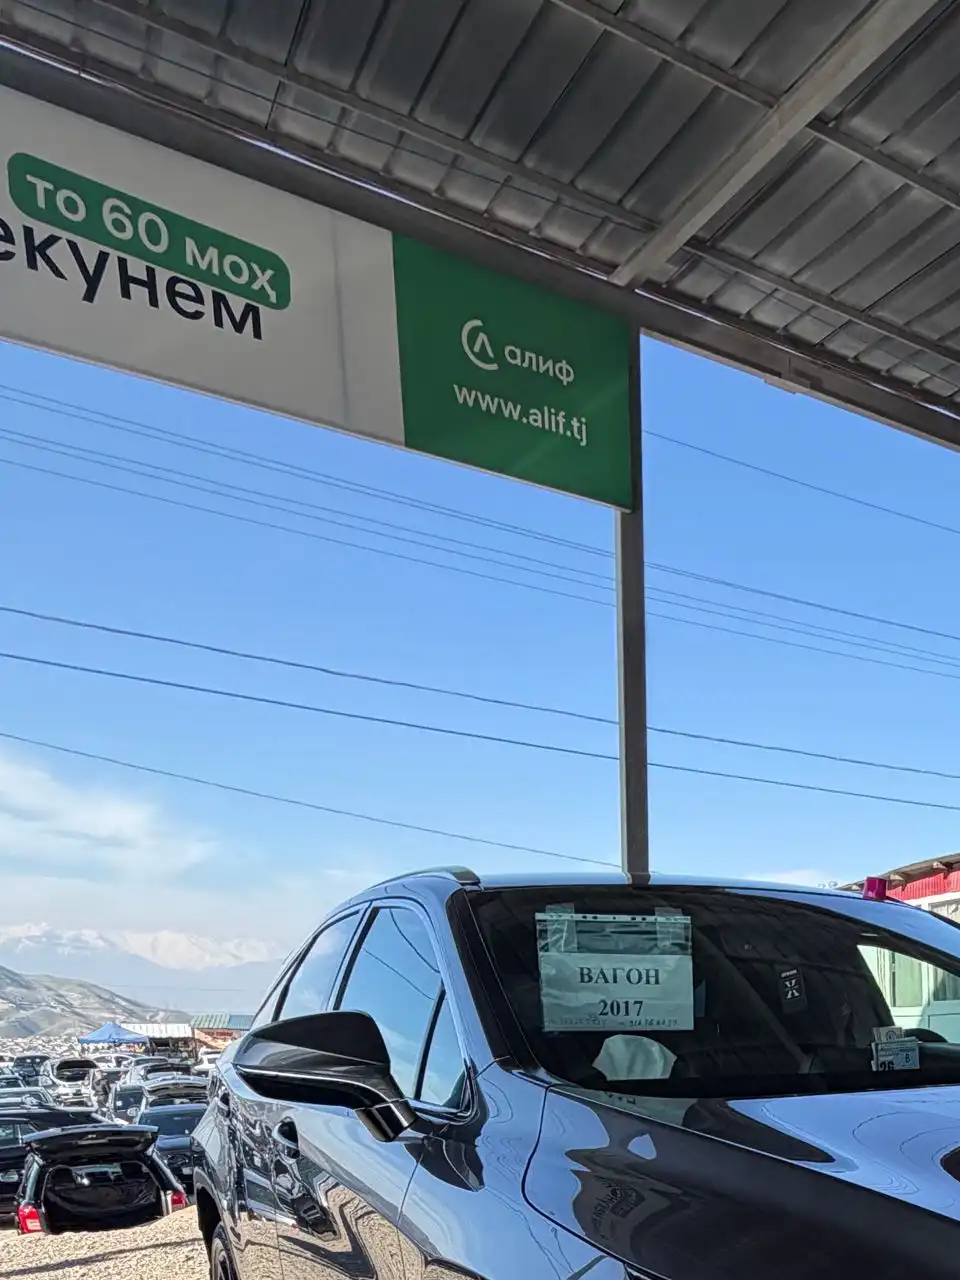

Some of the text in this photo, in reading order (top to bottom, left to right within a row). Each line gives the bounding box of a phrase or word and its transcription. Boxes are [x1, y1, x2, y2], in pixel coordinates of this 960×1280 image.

[26, 174, 86, 222] то
[102, 198, 169, 253] 60
[504, 345, 575, 386] алиф
[453, 384, 587, 446] www.alif.tj
[578, 966, 661, 985] ВАГОН
[599, 1000, 644, 1017] 2017
